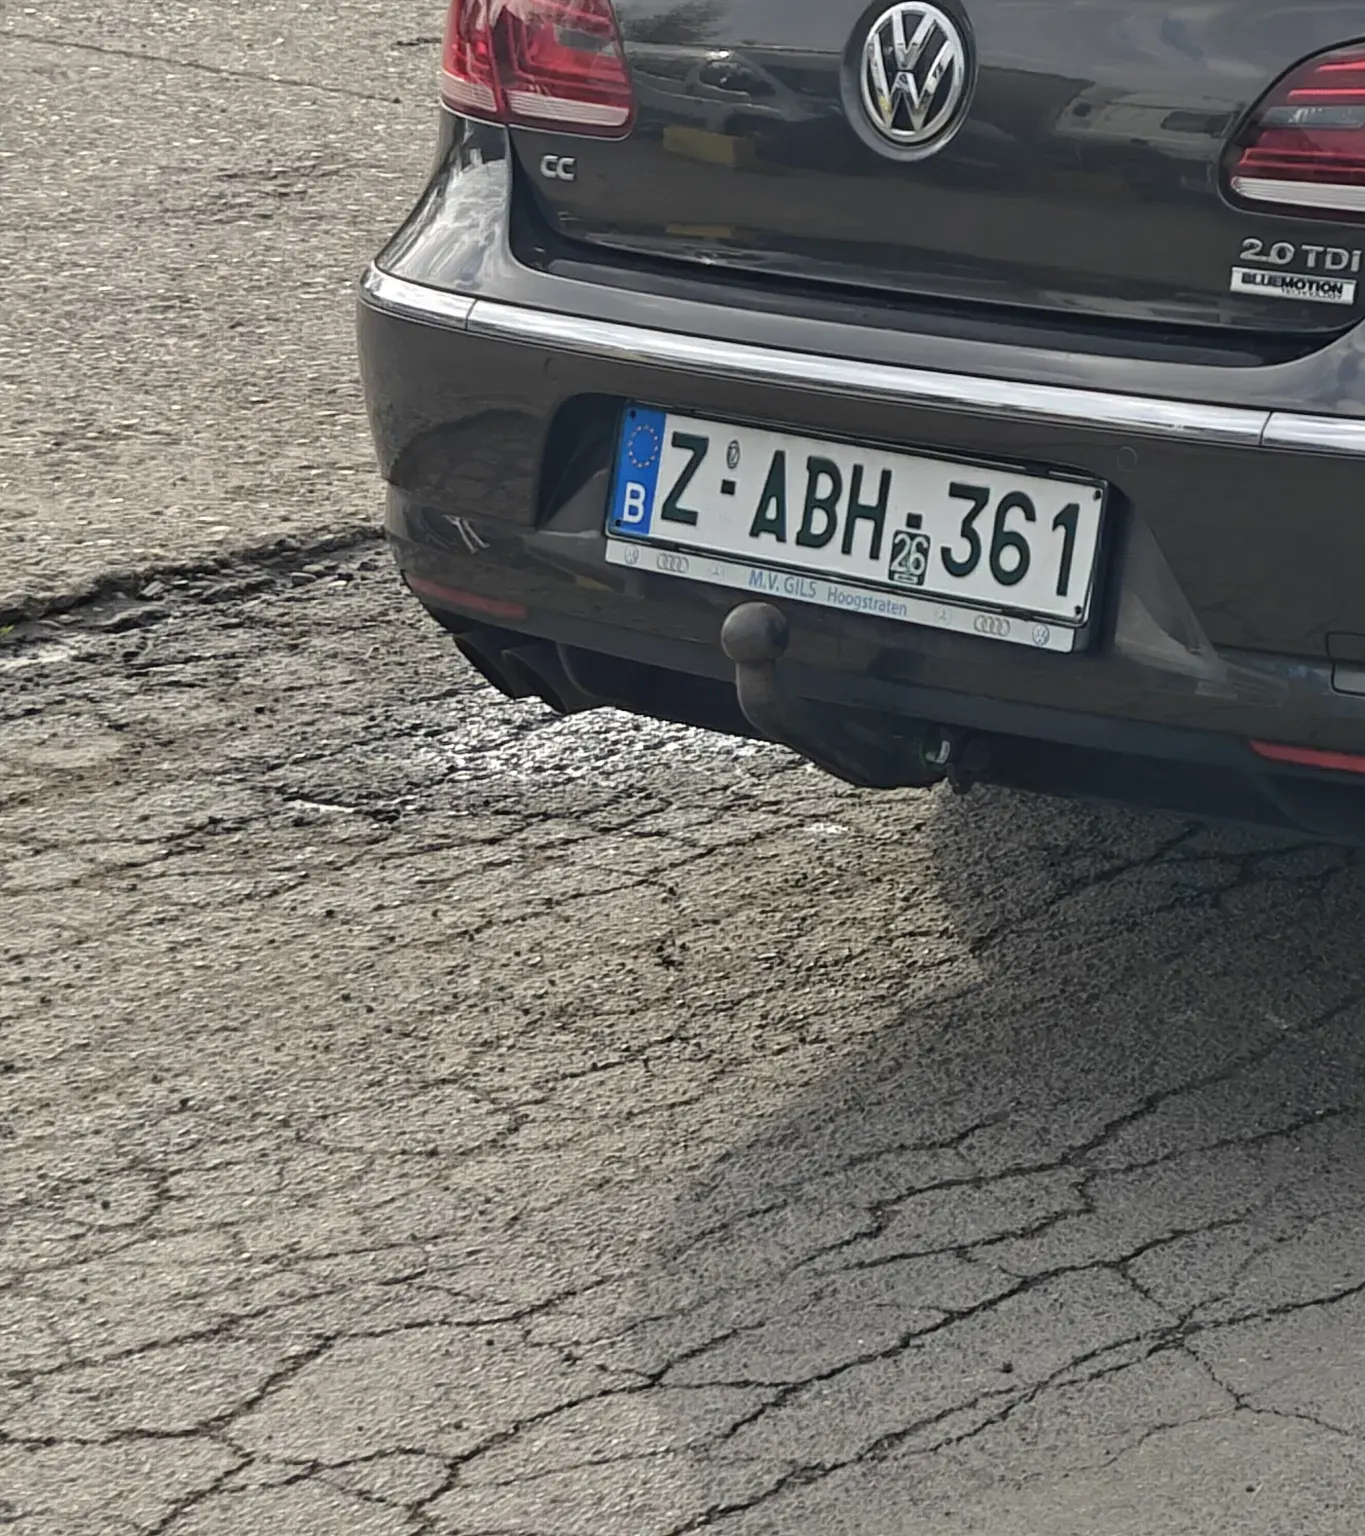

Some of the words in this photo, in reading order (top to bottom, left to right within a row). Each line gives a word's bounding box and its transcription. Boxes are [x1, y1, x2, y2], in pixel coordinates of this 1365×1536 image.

[541, 154, 576, 181] CC
[1301, 244, 1363, 272] TDI
[623, 482, 646, 524] B
[891, 533, 929, 576] 26
[783, 576, 817, 598] GILS
[826, 586, 908, 617] Hoogstraten
